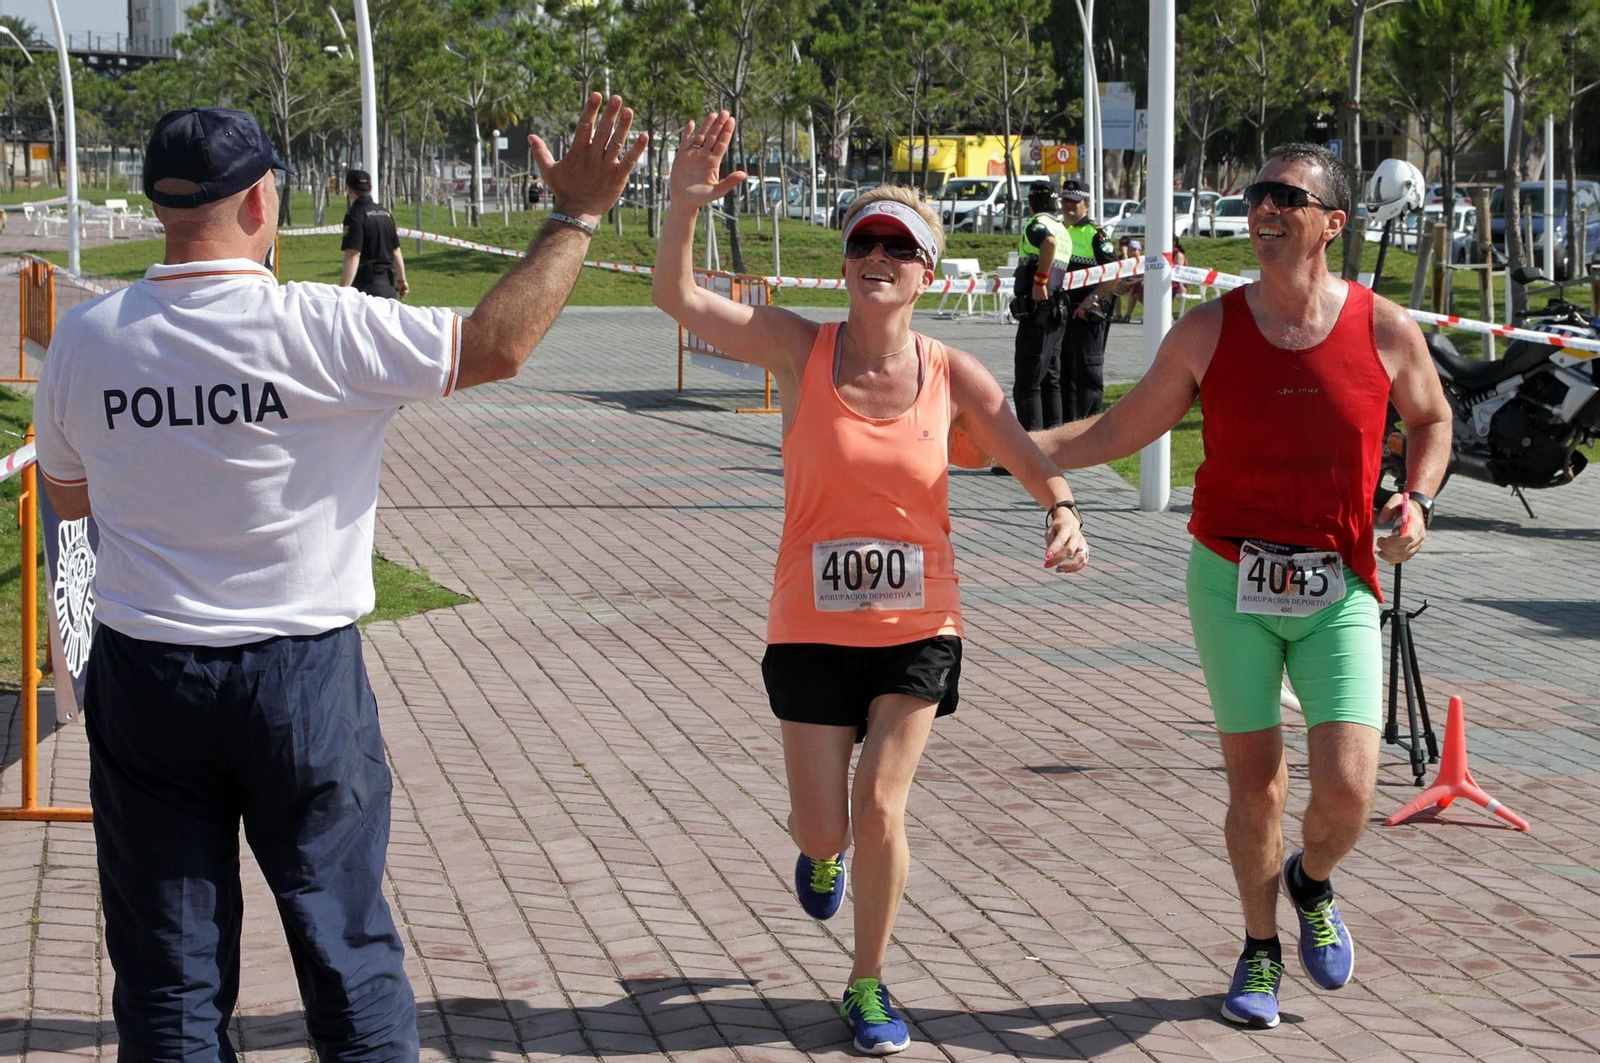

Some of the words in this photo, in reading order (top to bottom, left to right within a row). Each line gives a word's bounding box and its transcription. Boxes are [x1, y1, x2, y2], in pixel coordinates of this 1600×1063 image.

[104, 382, 288, 429] POLICIA
[821, 549, 906, 591] 4090
[1247, 557, 1329, 597] 4045
[819, 592, 867, 601] AGRUPACIÓN
[869, 591, 912, 600] DEPORTIVA
[1242, 595, 1290, 604] AGRUPACIÓN
[1291, 598, 1332, 607] DEPORTIVA
[1281, 606, 1293, 614] 4045
